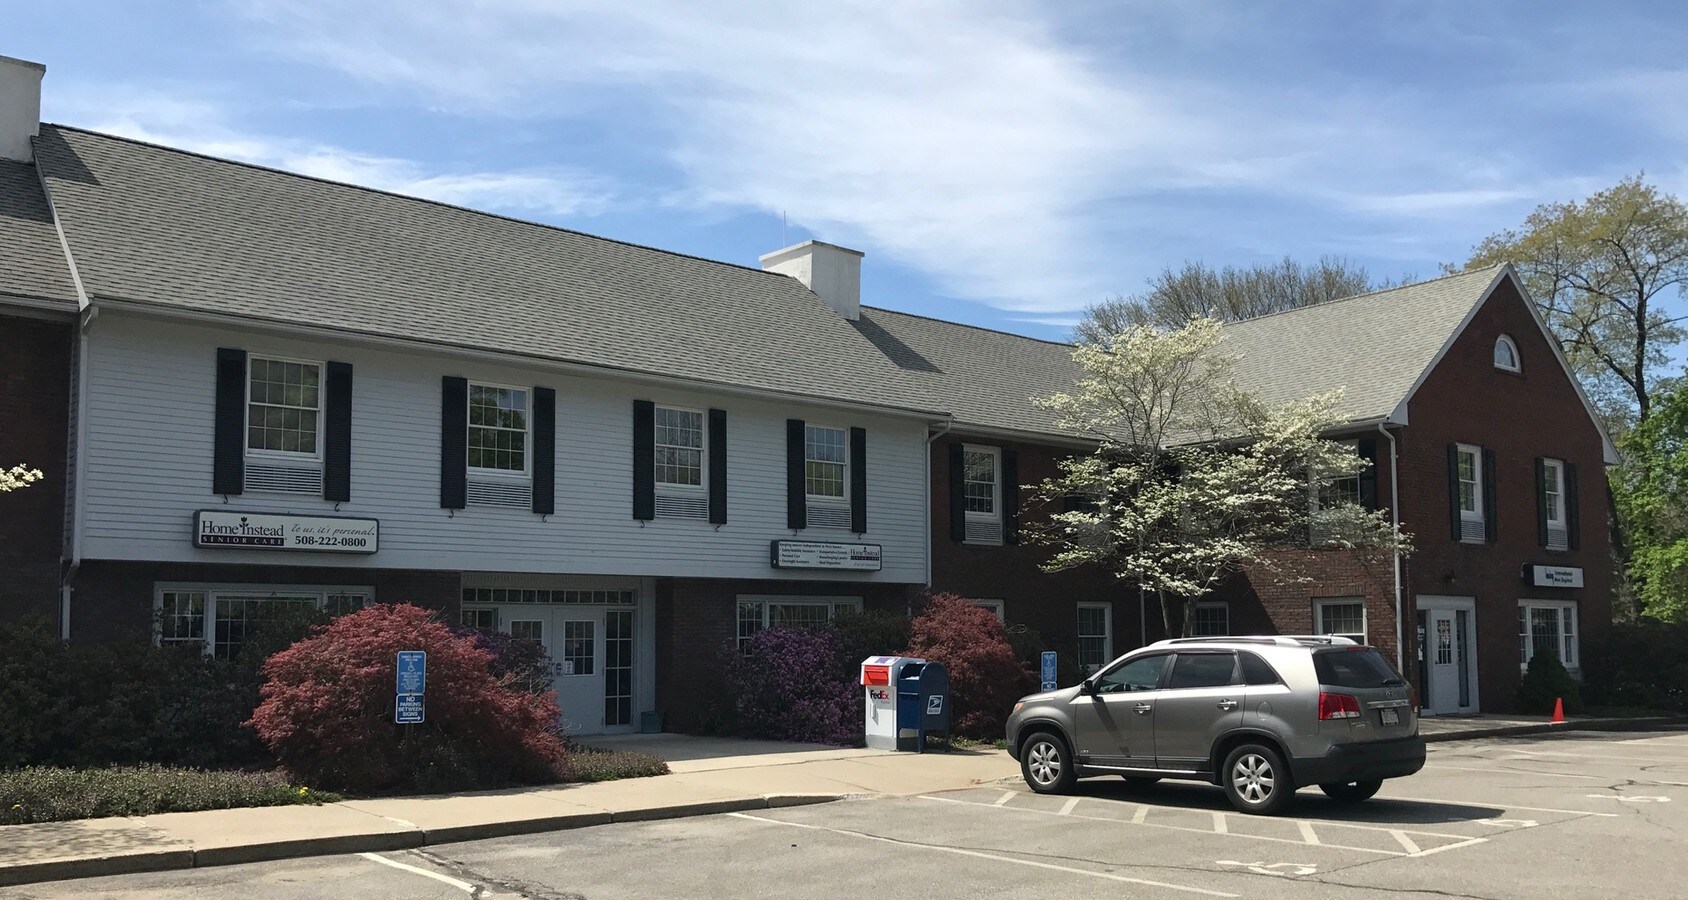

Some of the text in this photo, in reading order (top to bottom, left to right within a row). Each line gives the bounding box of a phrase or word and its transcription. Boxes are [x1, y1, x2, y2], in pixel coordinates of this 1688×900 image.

[201, 520, 284, 537] Home Instead
[202, 535, 283, 546] SENIOR CARE
[294, 535, 367, 547] 508-222-0800
[870, 689, 890, 700] FedEx
